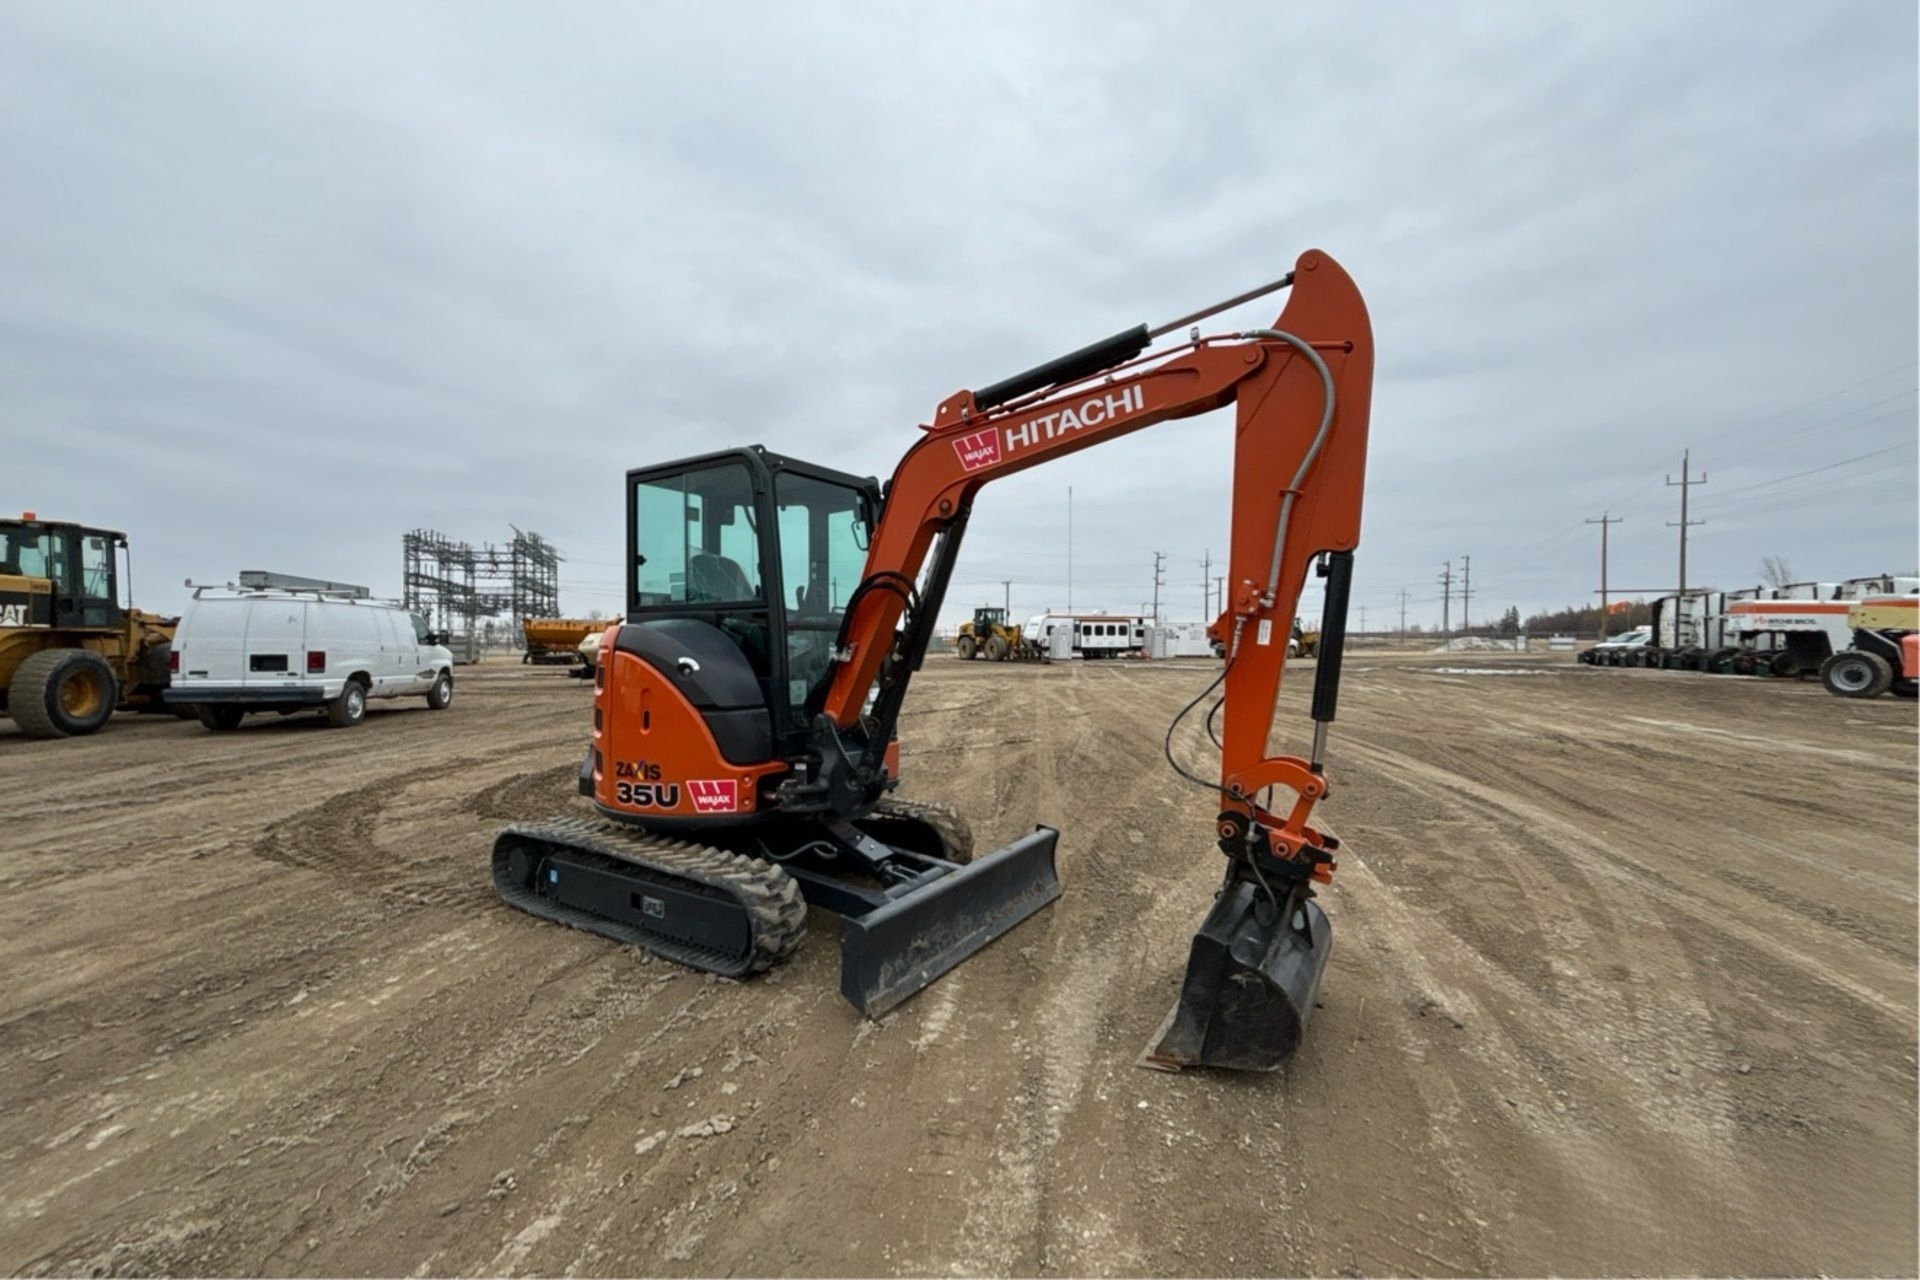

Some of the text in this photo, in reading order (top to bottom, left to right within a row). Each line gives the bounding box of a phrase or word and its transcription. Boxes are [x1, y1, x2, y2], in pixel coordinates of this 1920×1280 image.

[1006, 384, 1144, 451] HITACHI
[964, 445, 995, 462] WAJAX
[0, 604, 27, 626] AT
[616, 760, 661, 780] ZAXIS
[616, 781, 680, 808] 35U
[698, 795, 730, 806] WAJAX
